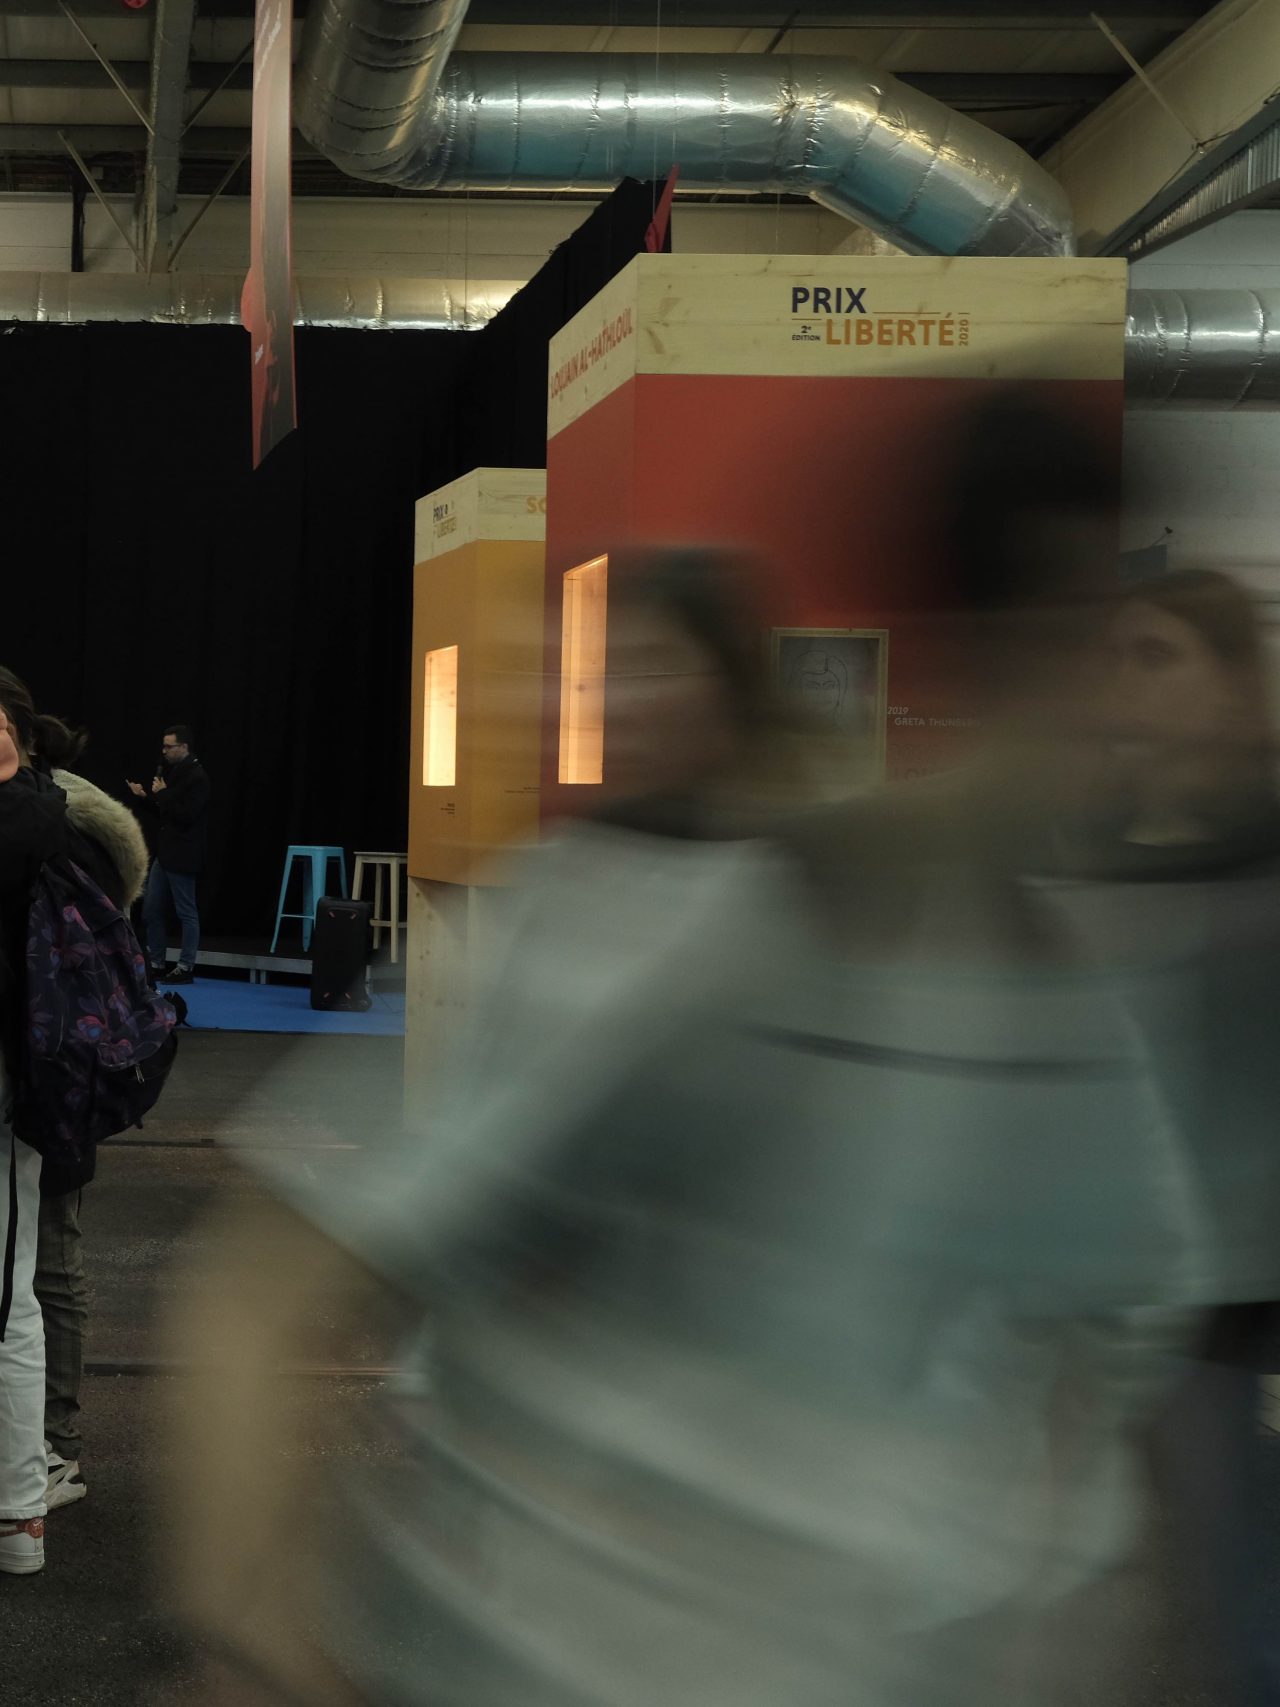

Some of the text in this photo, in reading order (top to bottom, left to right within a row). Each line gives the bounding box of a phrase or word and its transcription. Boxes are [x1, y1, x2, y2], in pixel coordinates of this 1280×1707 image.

[792, 287, 868, 314] PRIX
[792, 334, 822, 342] EDITION
[826, 312, 955, 347] LIBERTÉ
[958, 319, 970, 347] 2020
[887, 706, 910, 715] 2019
[895, 717, 927, 727] GRETA
